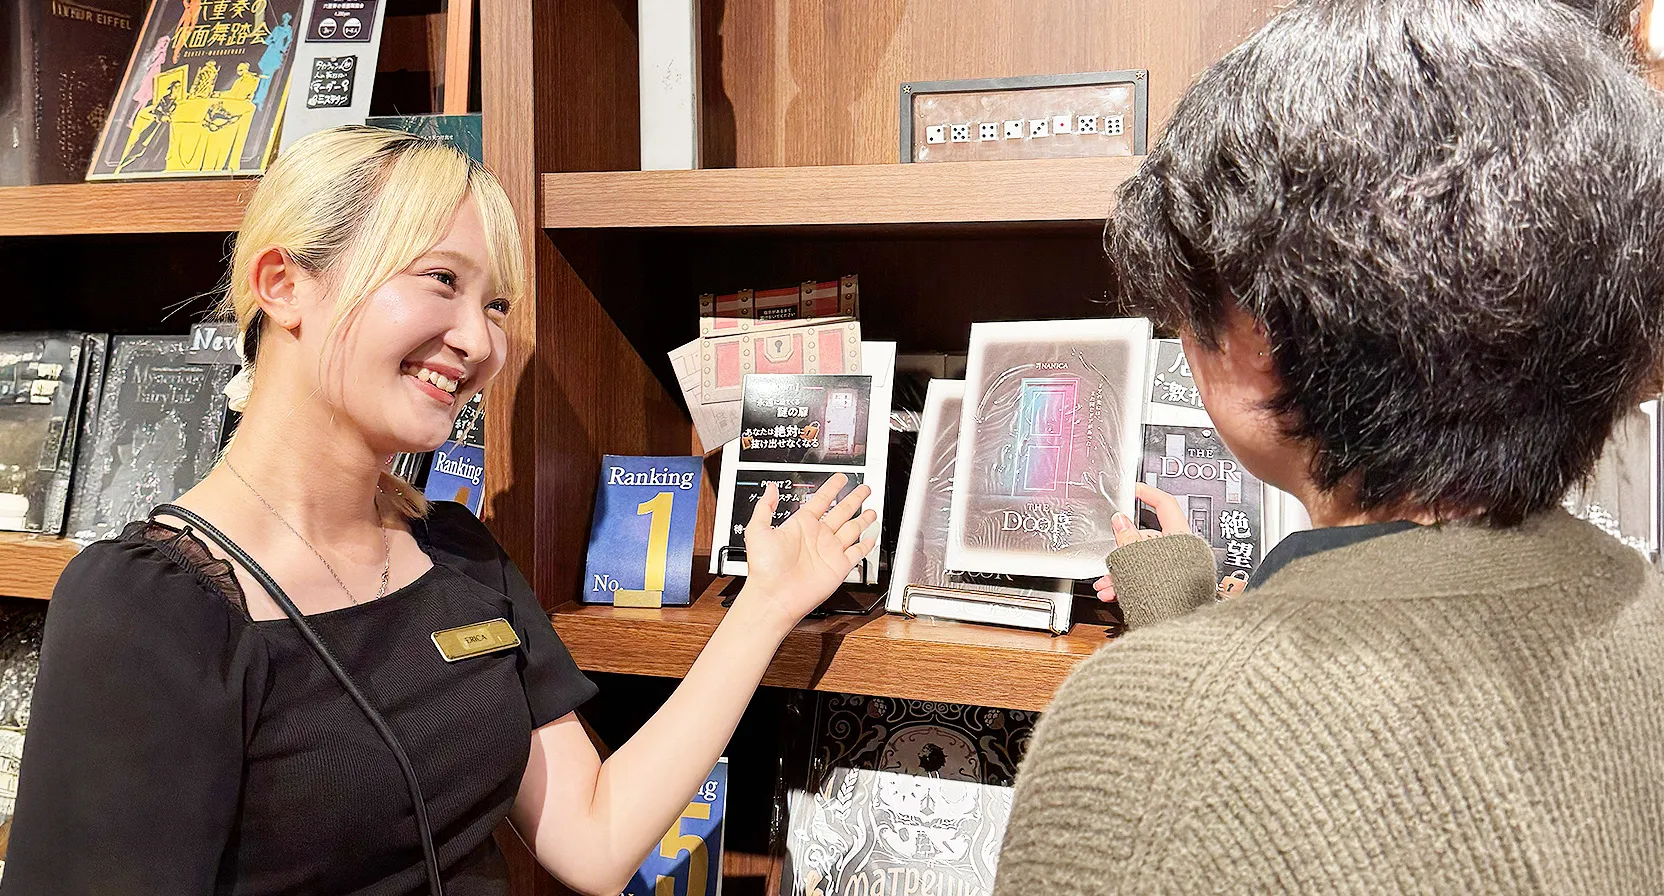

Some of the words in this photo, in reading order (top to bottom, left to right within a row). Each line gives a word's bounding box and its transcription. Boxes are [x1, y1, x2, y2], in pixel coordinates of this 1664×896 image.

[96, 14, 132, 31] EIFFEL
[1187, 449, 1215, 459] THE
[434, 451, 484, 485] Ranking
[607, 466, 695, 490] Ranking
[637, 491, 675, 592] 1
[1219, 509, 1255, 569] 絶望
[592, 574, 624, 592] No.
[464, 634, 488, 645] ERICA
[653, 801, 711, 896] 5
